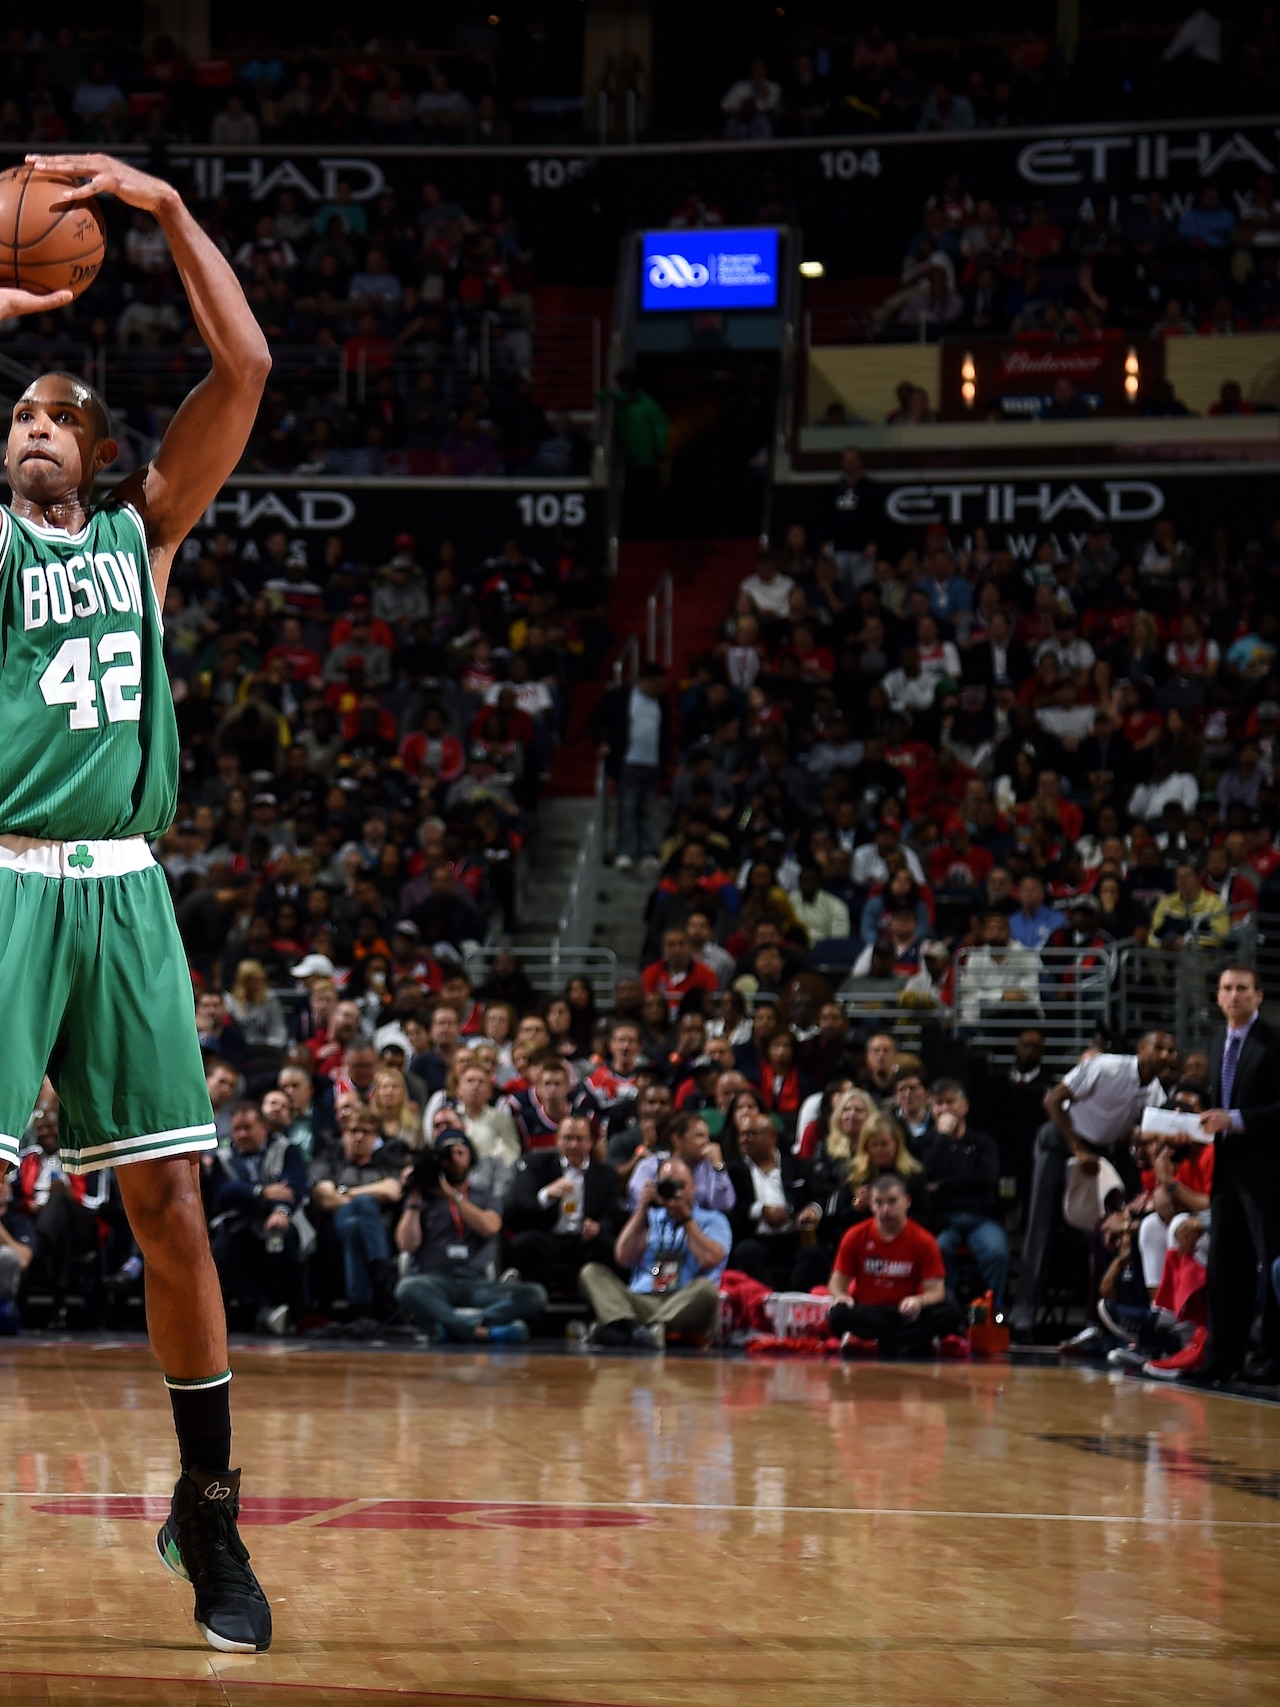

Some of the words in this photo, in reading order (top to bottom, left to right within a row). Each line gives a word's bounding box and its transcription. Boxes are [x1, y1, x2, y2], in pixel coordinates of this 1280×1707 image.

[819, 148, 884, 181] 104
[1016, 130, 1280, 186] ETIHA
[516, 492, 587, 528] 105
[883, 480, 1167, 526] ETIHAD
[23, 550, 143, 632] BOSTON
[38, 630, 142, 730] 42
